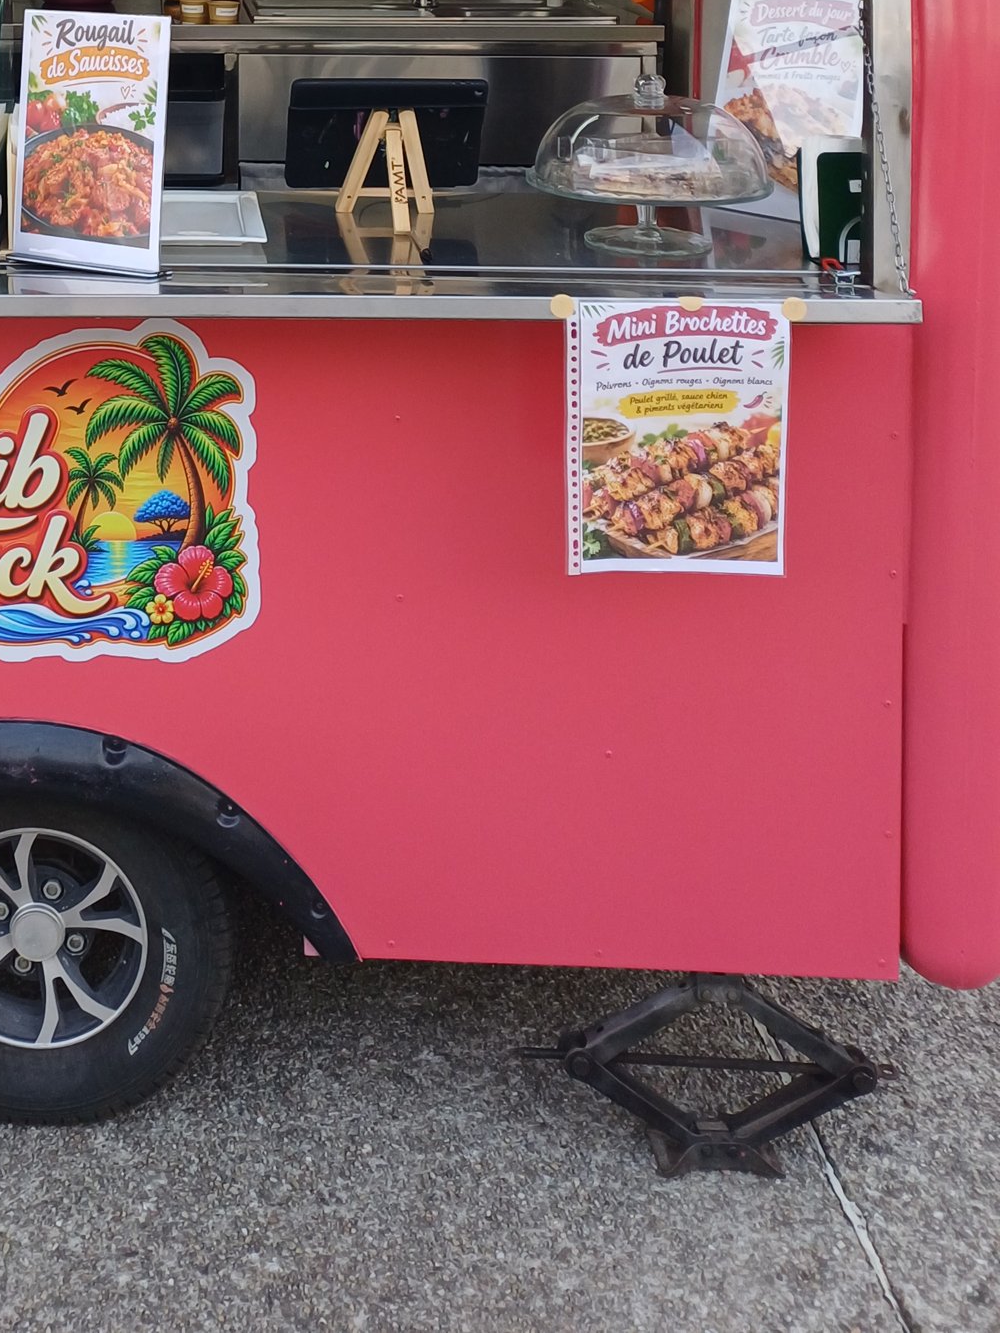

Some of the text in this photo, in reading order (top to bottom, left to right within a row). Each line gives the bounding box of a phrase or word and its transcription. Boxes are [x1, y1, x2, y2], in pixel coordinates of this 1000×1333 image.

[757, 3, 852, 24] Dessert du jour
[56, 19, 135, 51] Rougail
[757, 25, 838, 48] Tarte façon
[47, 49, 144, 78] de Saucisses
[760, 44, 842, 70] Crumble
[606, 310, 767, 343] Mini Brochettes
[623, 338, 744, 369] de Poulet
[596, 381, 632, 391] Poivrons
[642, 378, 673, 389] Oignons
[676, 378, 702, 387] rouges
[713, 377, 744, 387] Oignons
[747, 377, 773, 386] blancs
[630, 394, 653, 405] Poulet
[706, 390, 728, 400] chien
[644, 403, 676, 416] piments
[677, 401, 723, 412] végétariens
